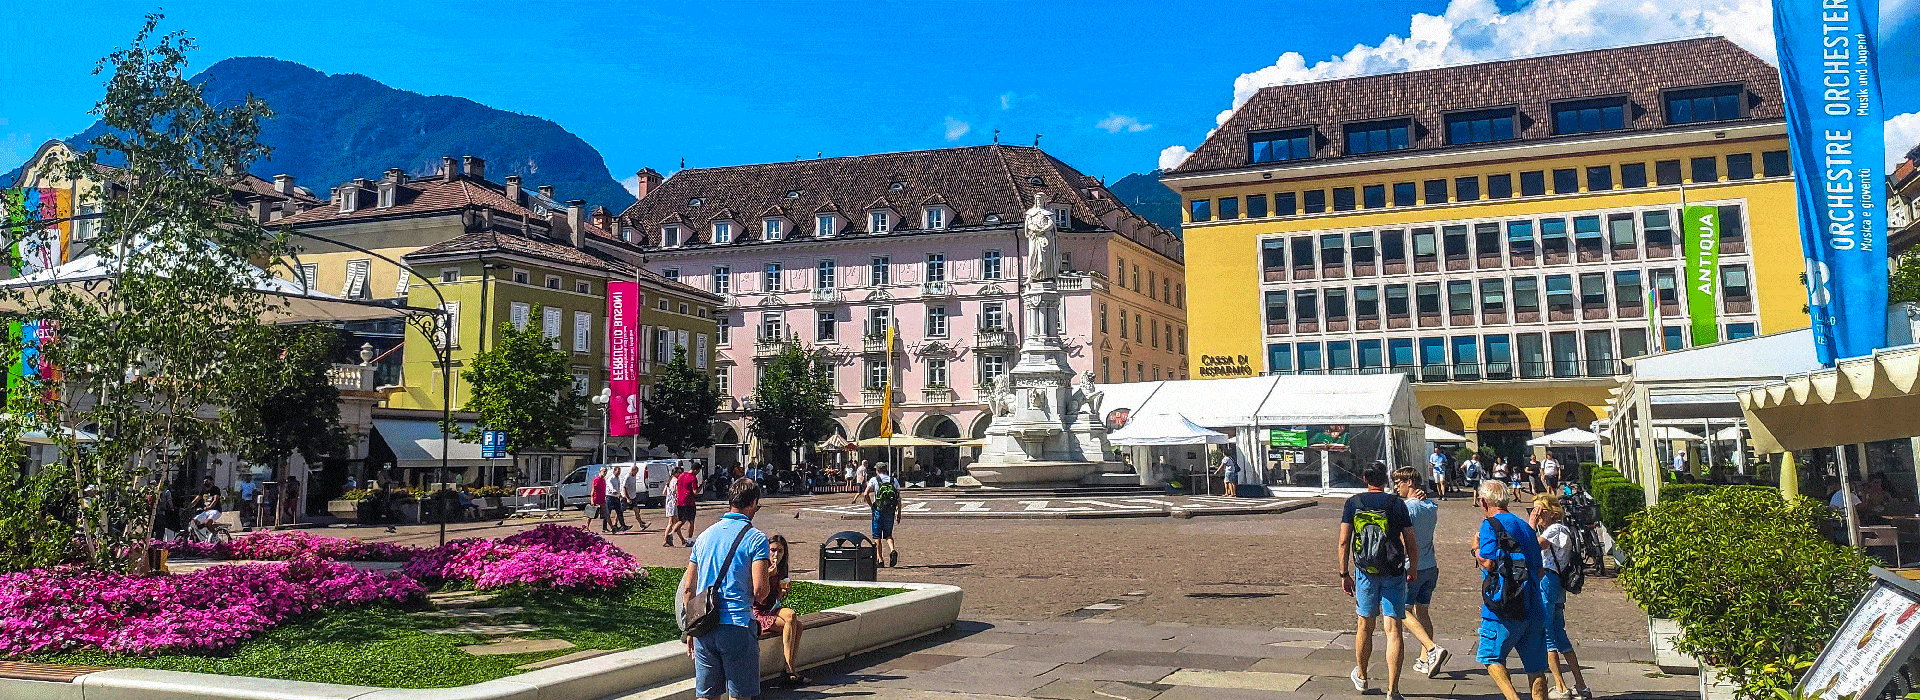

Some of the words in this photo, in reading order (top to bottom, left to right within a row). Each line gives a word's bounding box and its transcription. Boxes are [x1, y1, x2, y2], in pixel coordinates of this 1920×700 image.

[1823, 0, 1851, 116] ORCHESTER
[1855, 33, 1870, 66] Jugend
[1855, 69, 1868, 86] und
[1856, 89, 1869, 116] Musik
[1825, 129, 1855, 251] ORCHESTRE
[1858, 168, 1875, 209] gioventù
[1860, 219, 1873, 252] Musica
[1698, 213, 1713, 295] ANTIQUA
[485, 435, 492, 445] P
[498, 435, 504, 445] P
